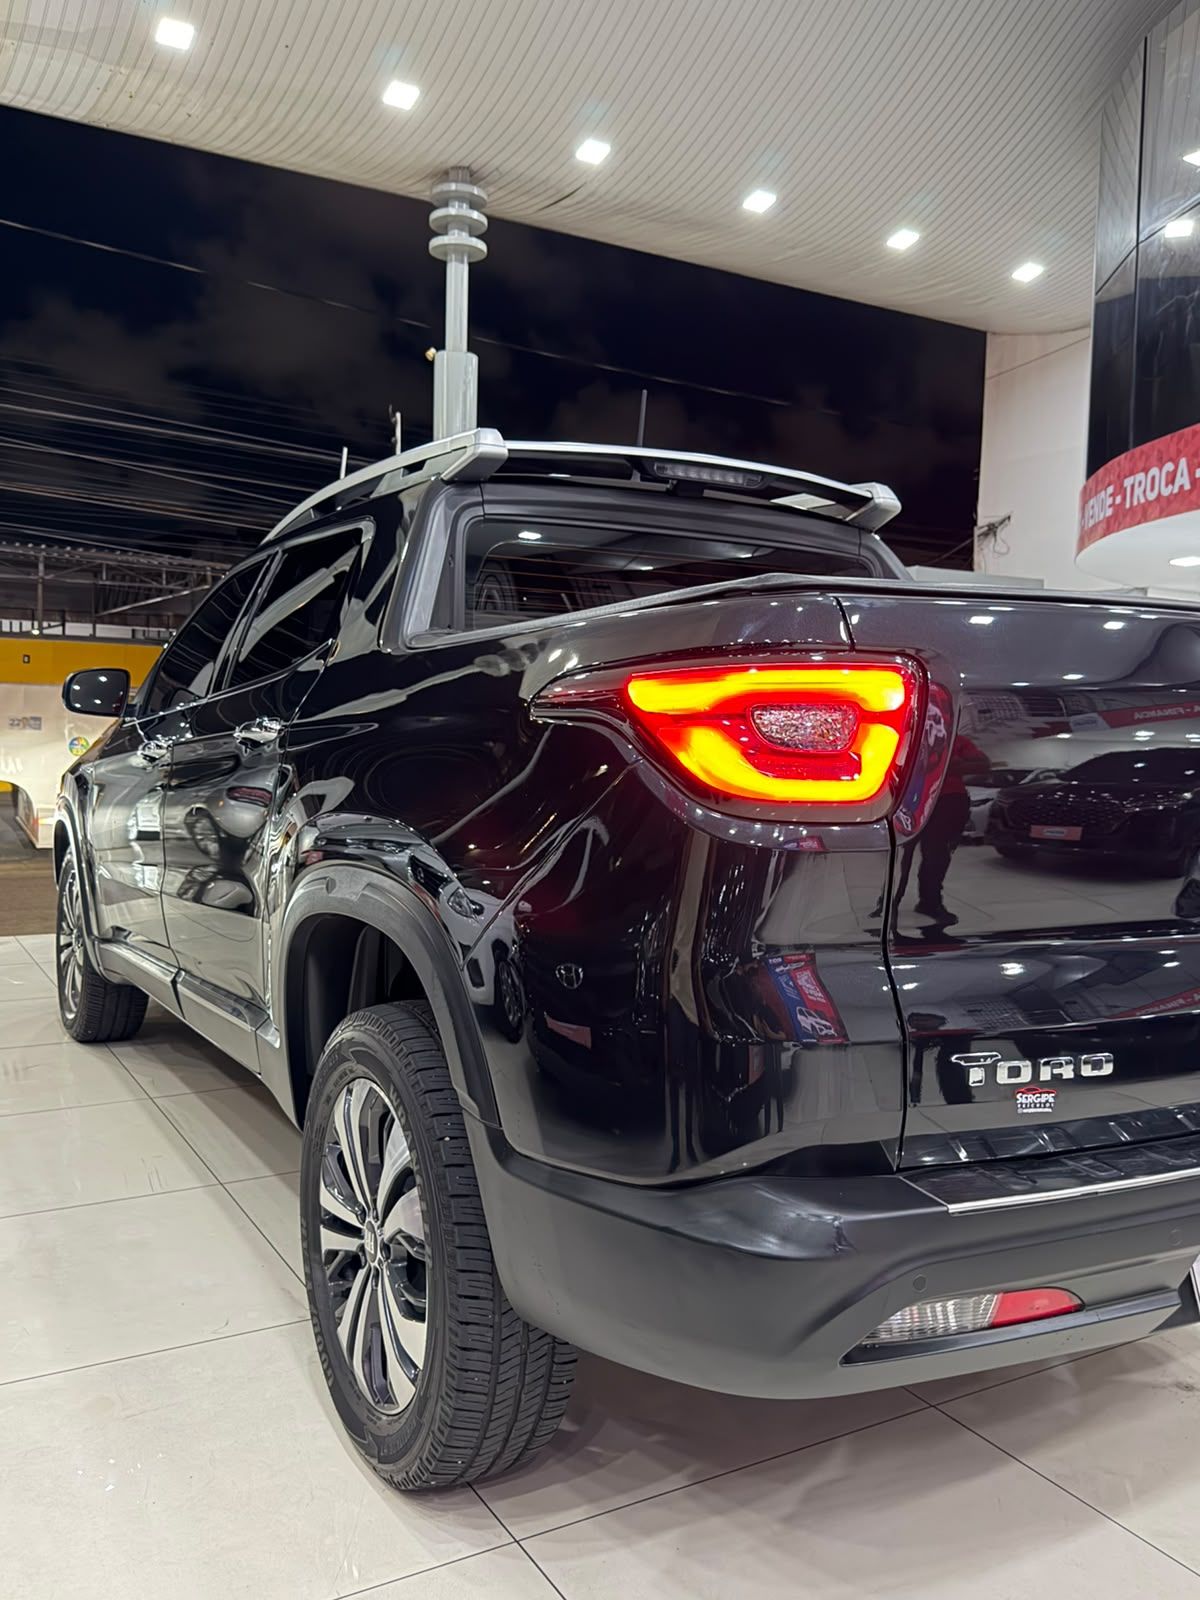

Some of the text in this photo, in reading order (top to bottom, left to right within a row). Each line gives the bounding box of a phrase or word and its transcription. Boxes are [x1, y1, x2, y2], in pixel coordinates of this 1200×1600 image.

[1124, 457, 1191, 509] TROCA
[951, 1052, 1114, 1087] TORO
[1016, 1093, 1056, 1103] SERGIPE
